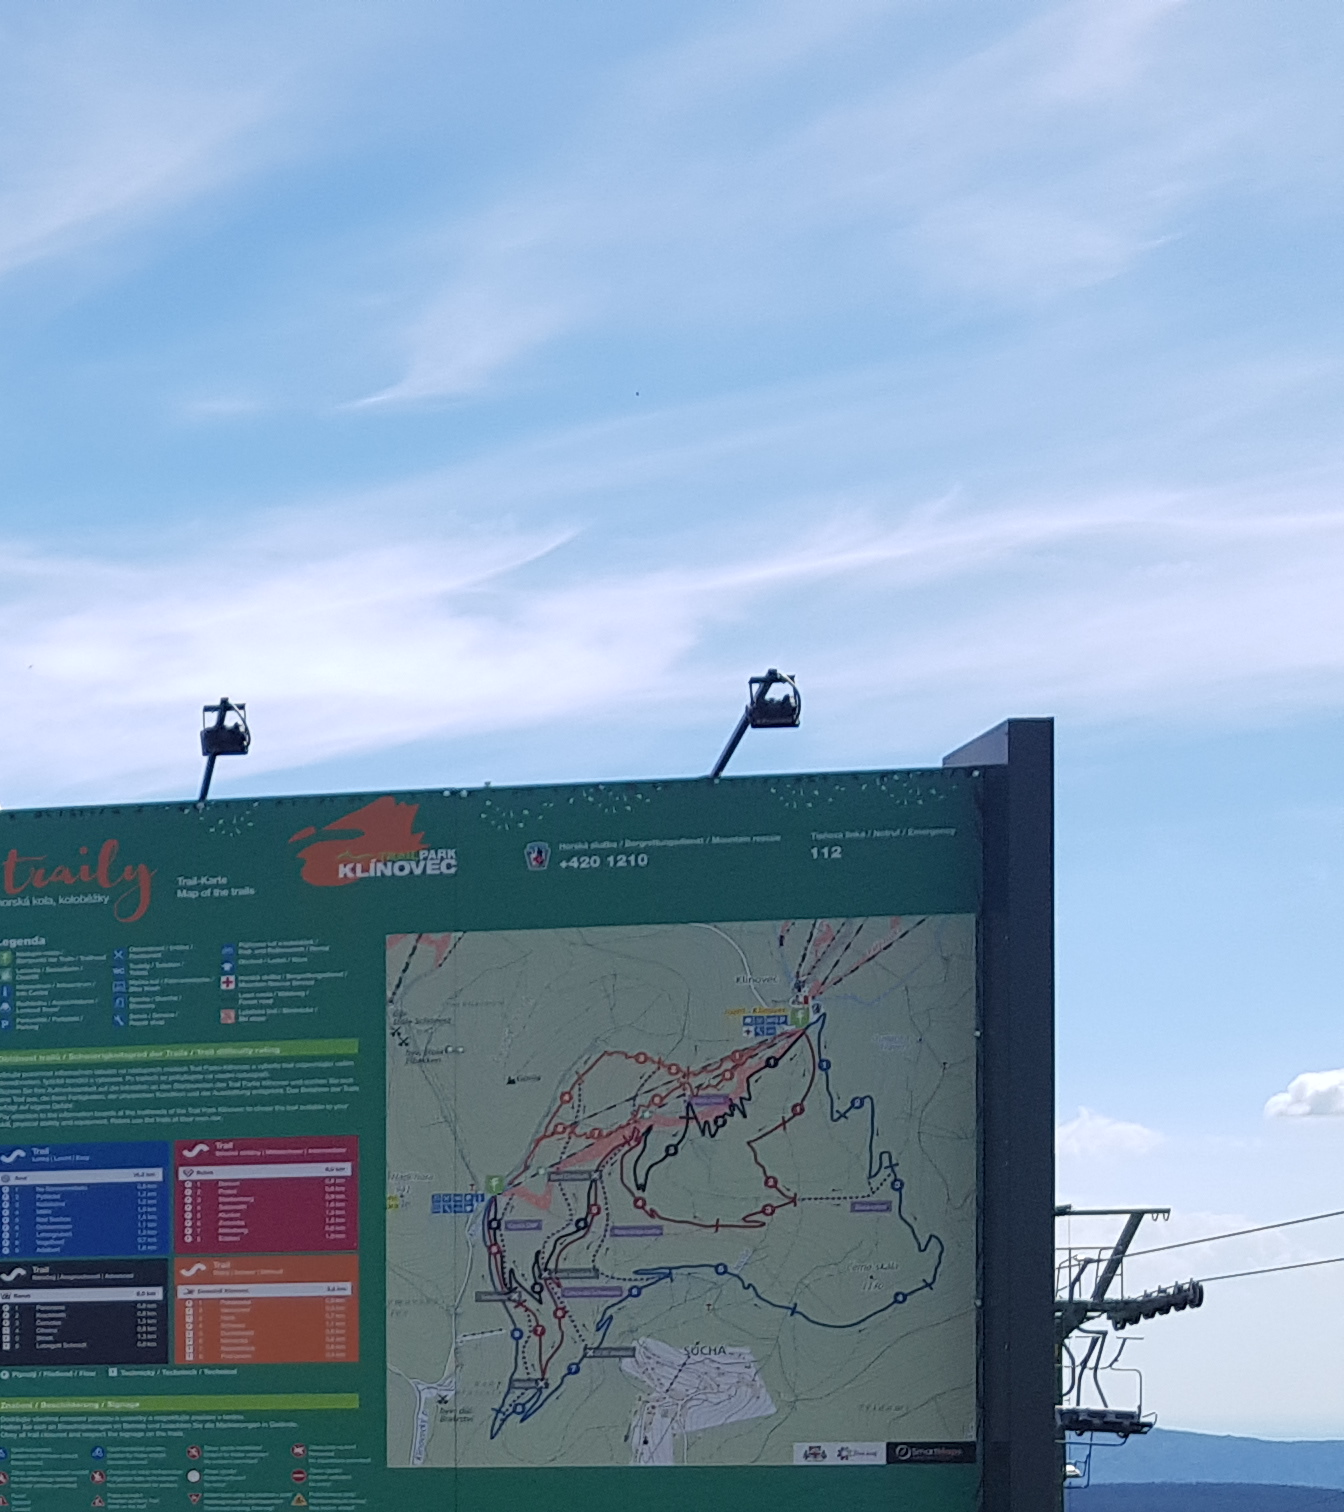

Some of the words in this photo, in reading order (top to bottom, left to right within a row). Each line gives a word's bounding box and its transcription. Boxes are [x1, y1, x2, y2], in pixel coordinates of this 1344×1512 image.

[811, 846, 842, 859] 112
[560, 854, 600, 868] +420
[607, 853, 648, 867] 1210
[338, 859, 456, 878] KLÍNOVEC
[2, 840, 157, 922] traily
[178, 890, 200, 898] Map
[32, 1145, 50, 1156] Trail
[215, 1141, 233, 1150] Trail
[32, 1264, 50, 1274] Trail
